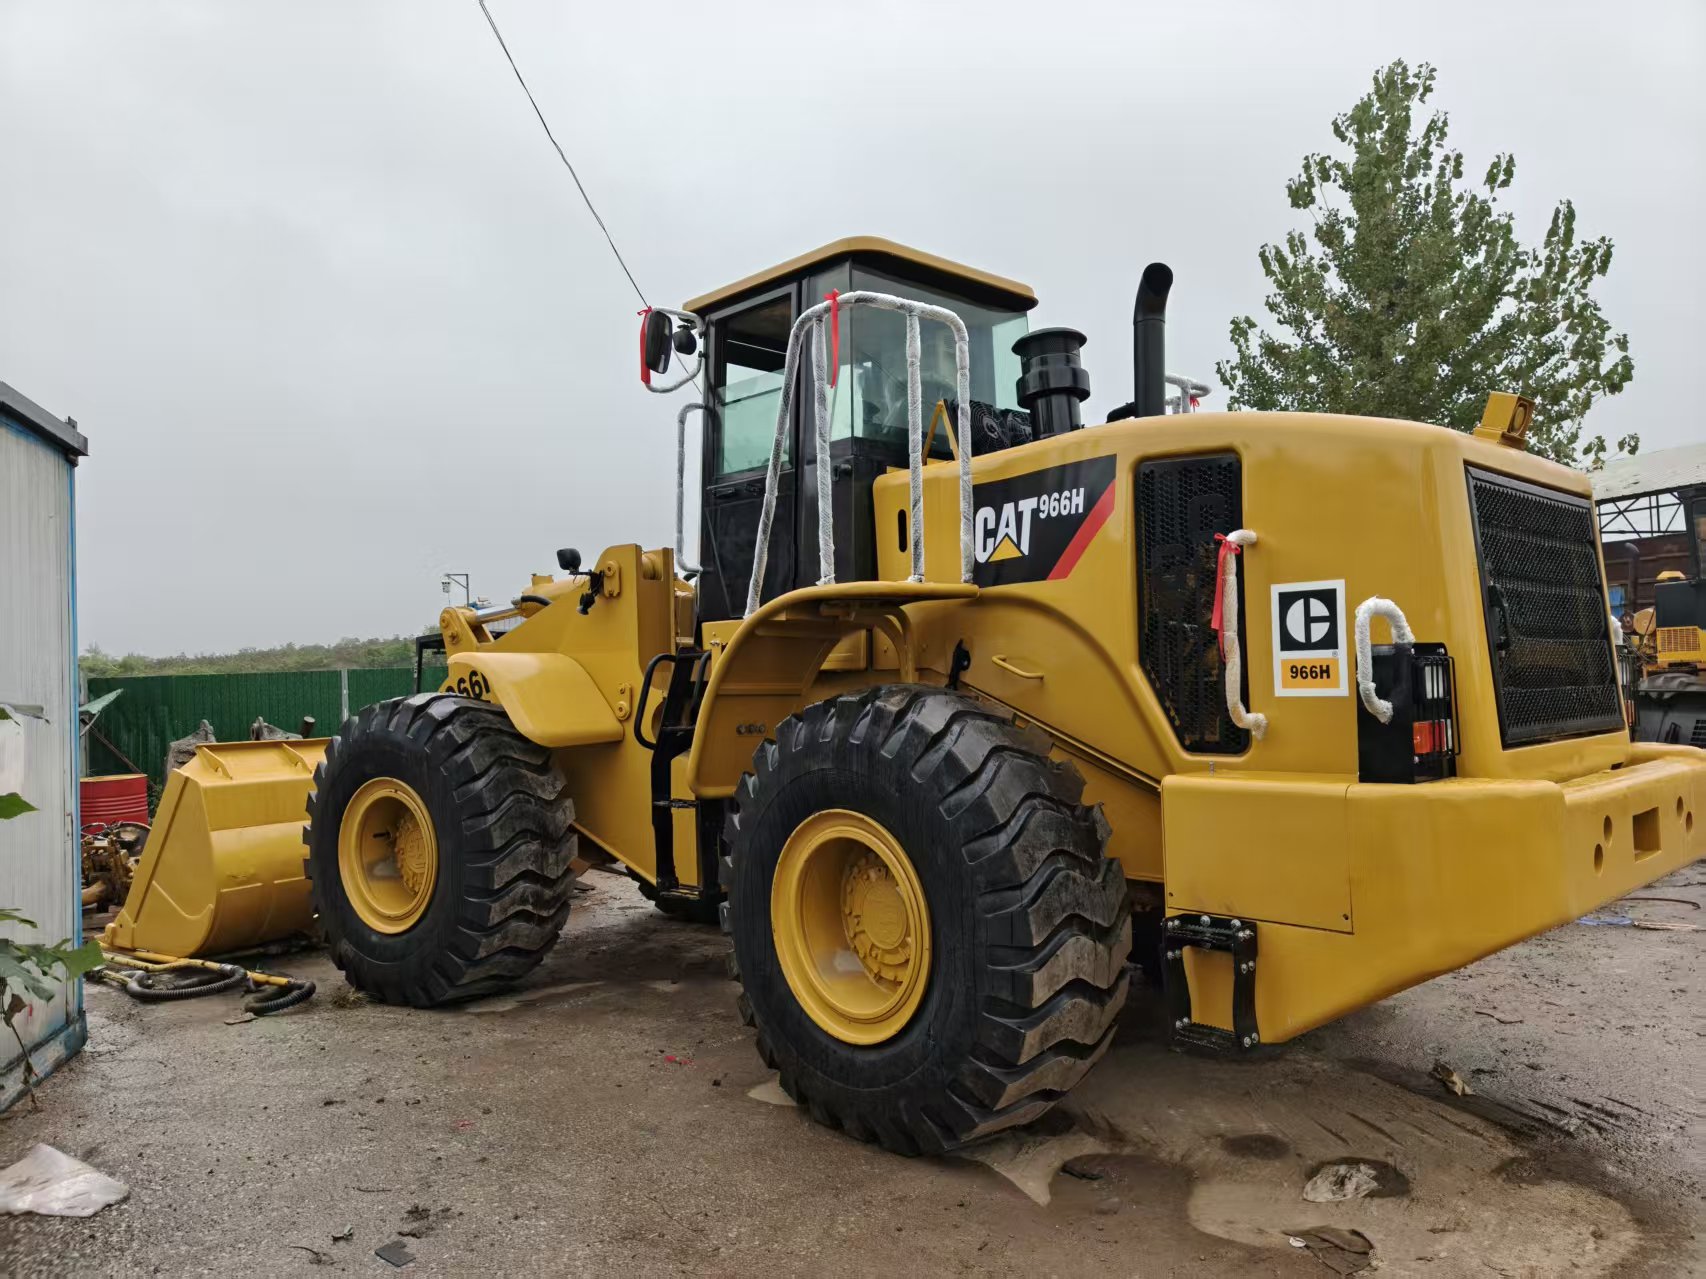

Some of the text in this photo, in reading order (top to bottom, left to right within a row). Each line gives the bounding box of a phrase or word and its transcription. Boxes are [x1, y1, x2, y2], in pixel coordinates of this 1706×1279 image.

[975, 487, 1085, 564] CAT 966H
[1290, 664, 1331, 680] 966H
